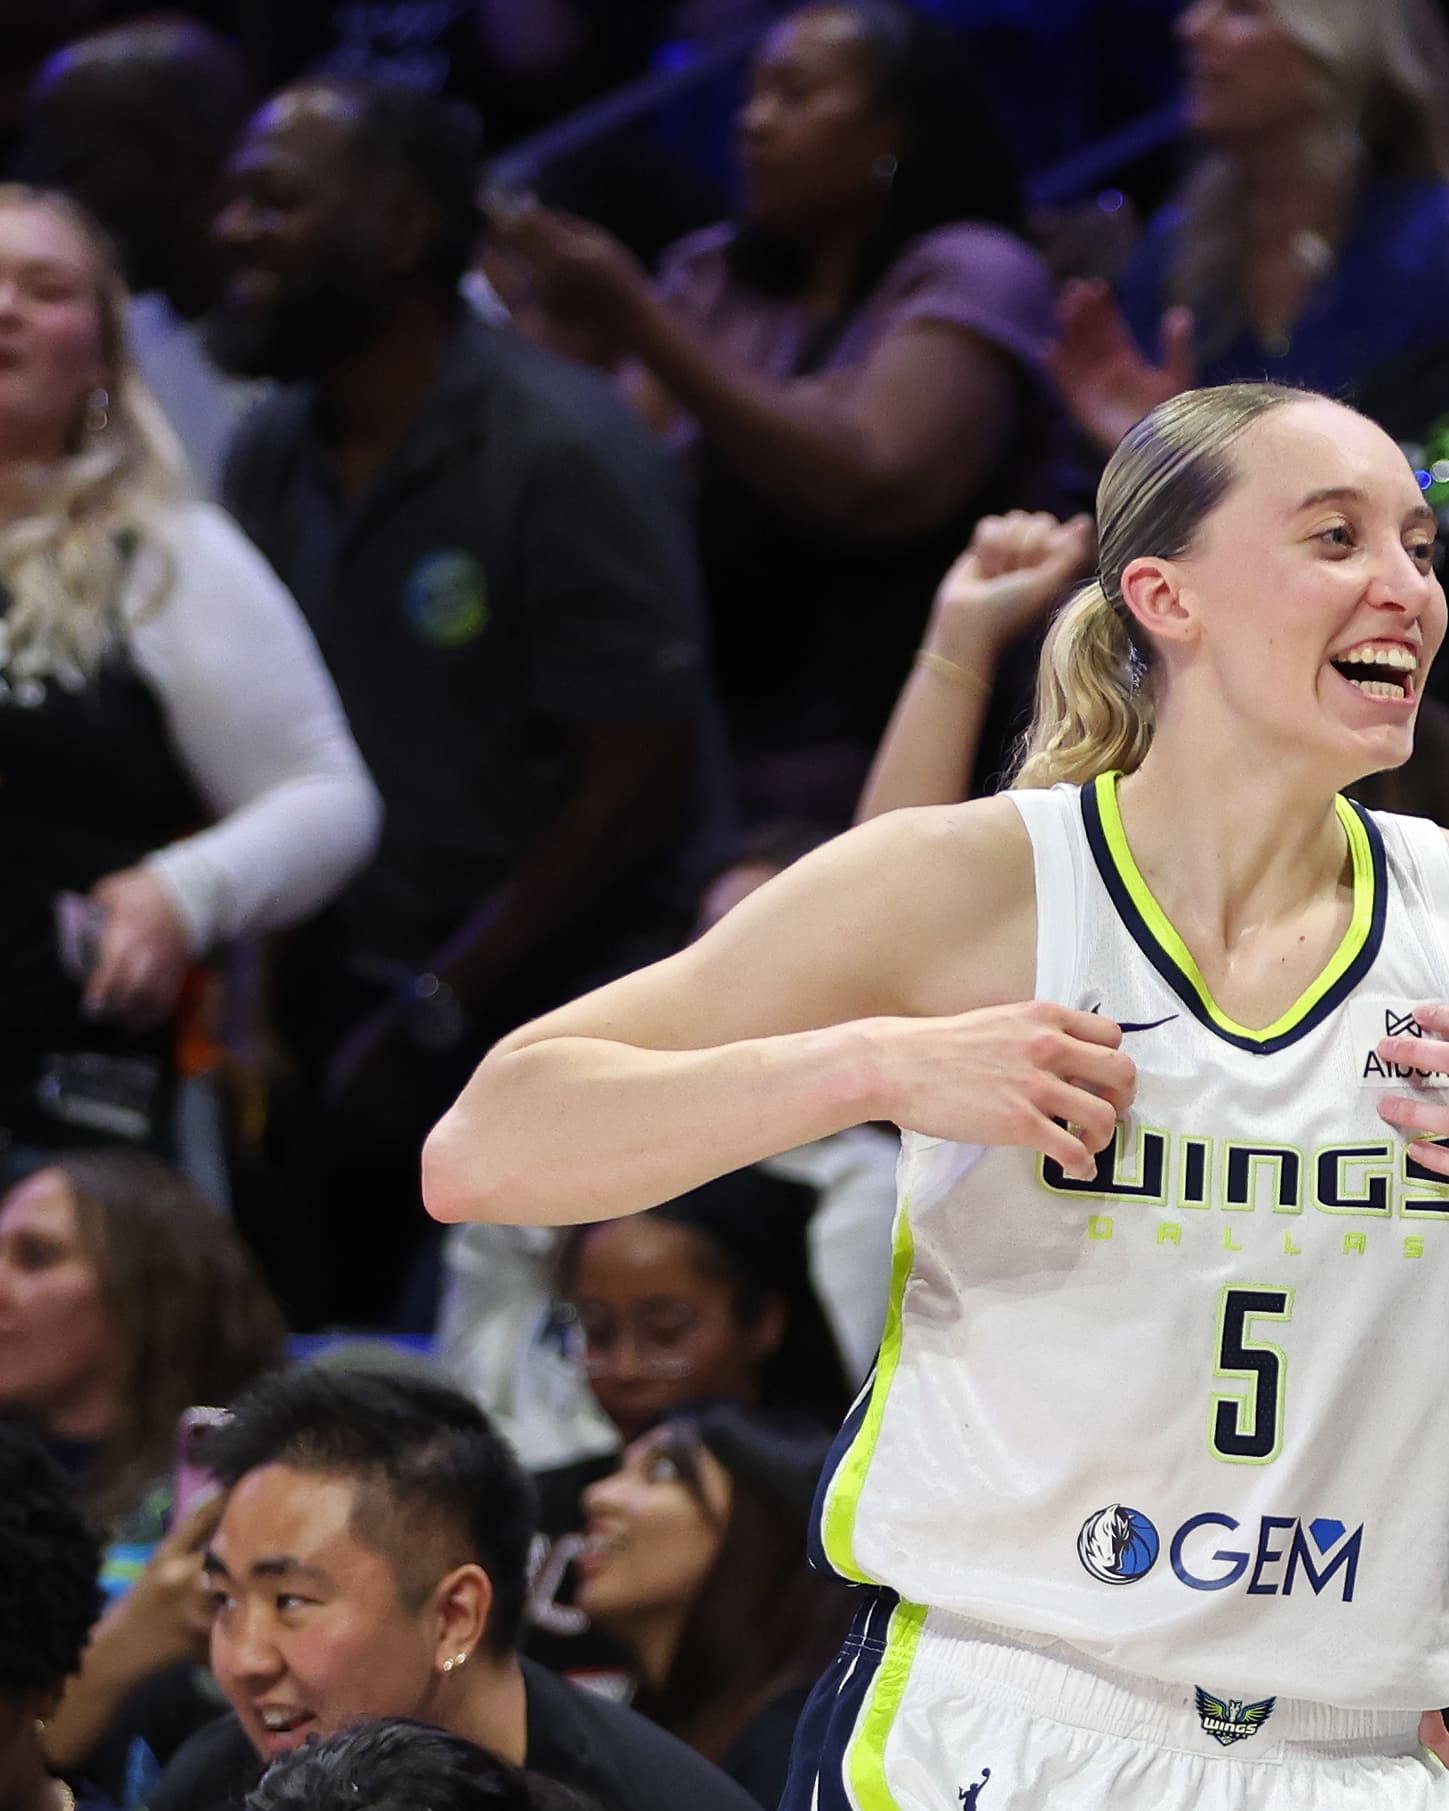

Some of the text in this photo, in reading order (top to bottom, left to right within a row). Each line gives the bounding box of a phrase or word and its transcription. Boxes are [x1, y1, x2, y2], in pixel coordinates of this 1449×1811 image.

[1088, 1216, 1426, 1259] DALLAS
[1207, 1282, 1296, 1466] 5
[1169, 1511, 1364, 1602] GEM
[1203, 1716, 1258, 1735] WINGS
